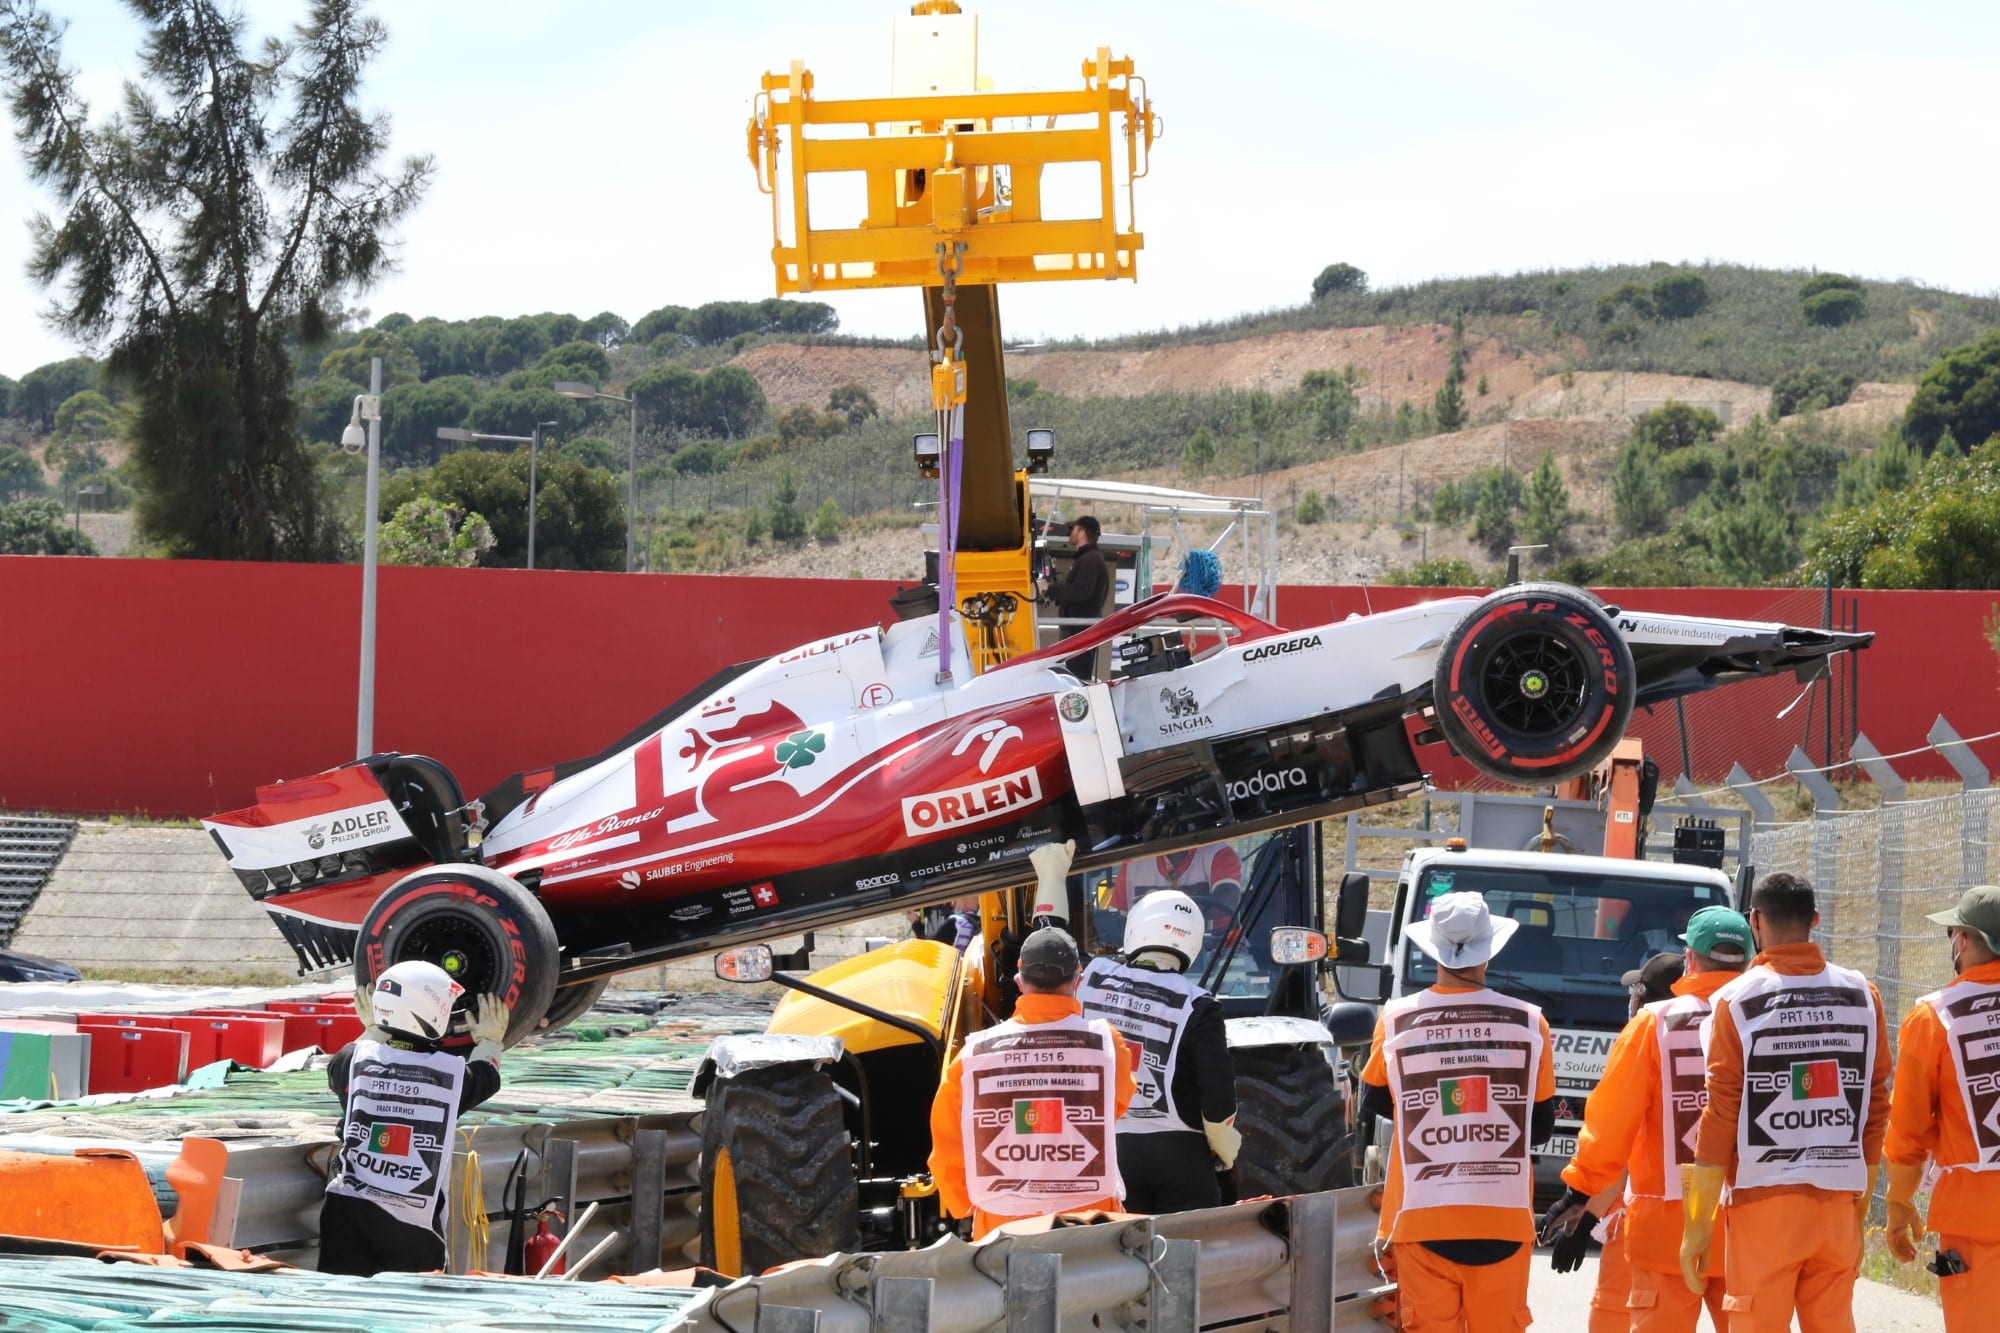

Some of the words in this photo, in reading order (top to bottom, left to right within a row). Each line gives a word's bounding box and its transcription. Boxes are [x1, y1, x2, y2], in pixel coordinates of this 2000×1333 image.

[1641, 623, 1680, 636] Additive
[1682, 628, 1728, 640] Industries
[779, 633, 872, 664] GIULIA
[1242, 635, 1322, 662] CARRERA
[1564, 612, 1618, 696] ZERO
[1159, 715, 1213, 735] SINGHA
[1451, 695, 1508, 760] PIRELLI
[1225, 767, 1307, 802] zadara
[911, 775, 1033, 828] ORLEN
[330, 810, 389, 836] ADLER
[548, 827, 594, 850] Alfa
[595, 806, 665, 835] Romeo
[646, 864, 682, 881] SAUBER
[685, 853, 734, 872] Engineering
[856, 873, 899, 890] sparco
[498, 918, 527, 1009] ZERO
[1105, 993, 1126, 1005] PRT
[1780, 1011, 1803, 1024] PRT
[1426, 1028, 1453, 1040] PRT
[1457, 1027, 1492, 1039] 1184
[1773, 1041, 1820, 1051] INTERVENTION
[1004, 1052, 1030, 1063] PRT
[1034, 1051, 1065, 1063] 1516
[1440, 1057, 1456, 1066] FIRE
[1457, 1054, 1490, 1065] MARSHAL
[372, 1081, 392, 1092] PRT
[997, 1079, 1049, 1089] INTERVENTION
[1050, 1077, 1086, 1087] MARSHAL
[1421, 1124, 1510, 1146] COURSE
[995, 1144, 1086, 1162] COURSE
